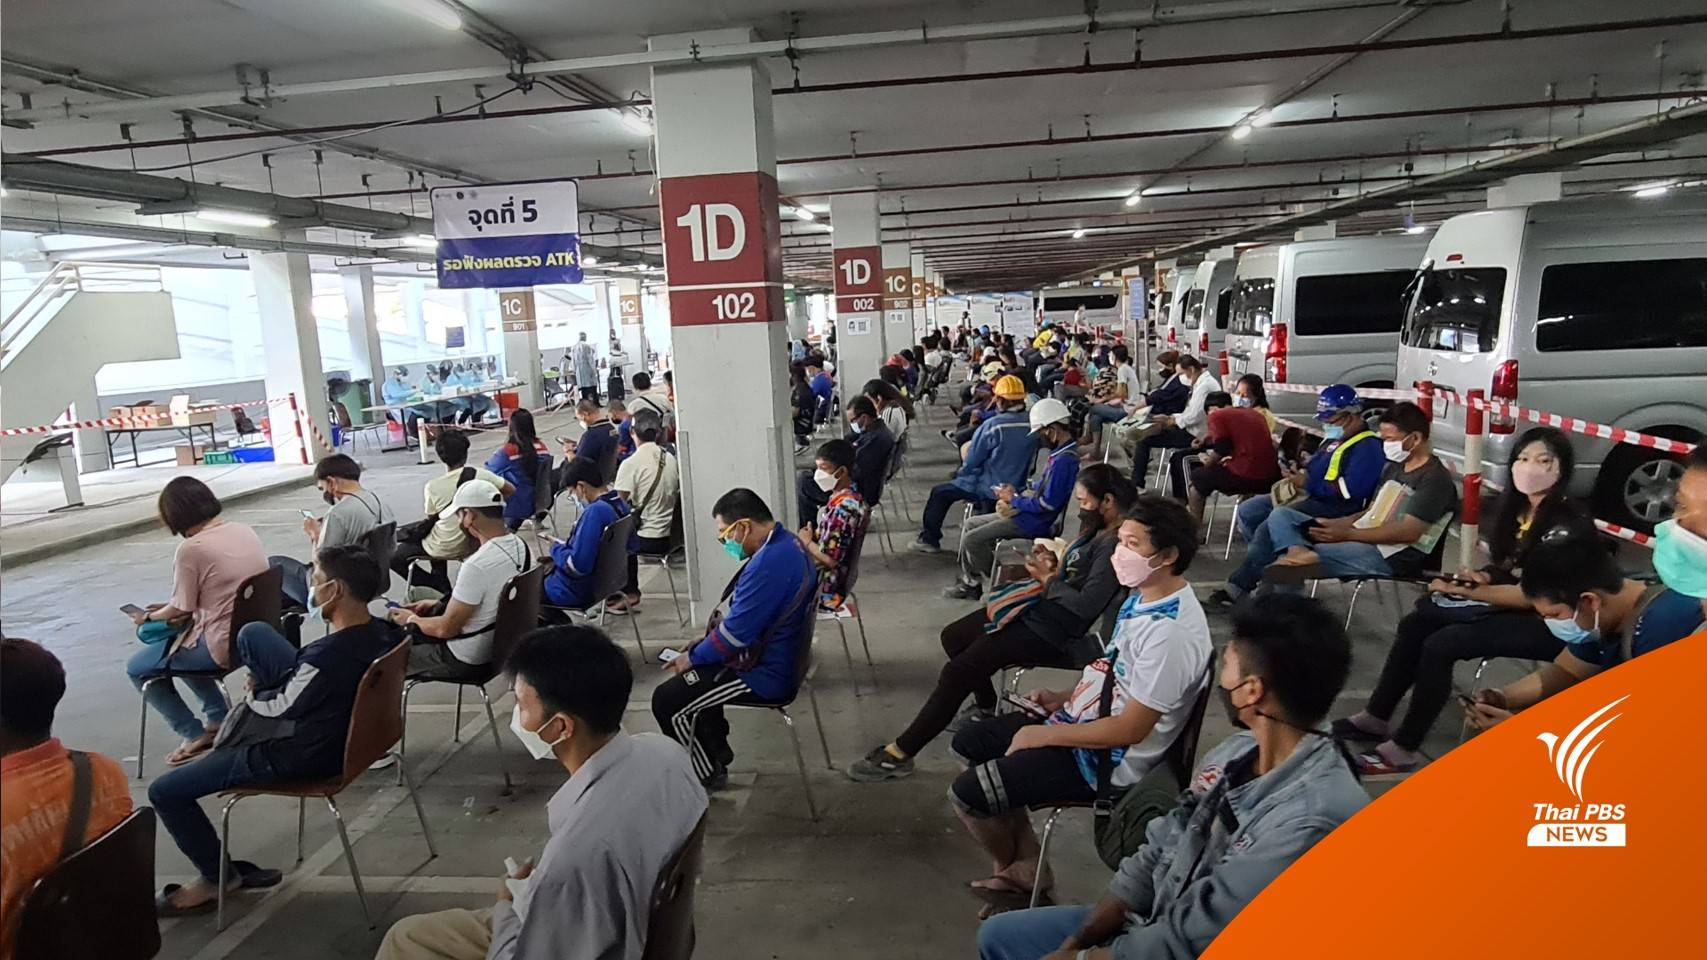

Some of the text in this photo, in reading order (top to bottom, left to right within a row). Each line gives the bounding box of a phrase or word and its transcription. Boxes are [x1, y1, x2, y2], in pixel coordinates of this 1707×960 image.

[468, 196, 538, 232] จุดที่ 5
[676, 203, 746, 262] 1D
[443, 252, 574, 271] รอฟังผลตรวจ ATK
[840, 259, 871, 286] 1D
[885, 275, 906, 293] 1C
[912, 282, 921, 296] C
[501, 298, 522, 316] 1C
[620, 300, 635, 313] 1C
[712, 292, 756, 320] 102
[853, 298, 875, 311] 002
